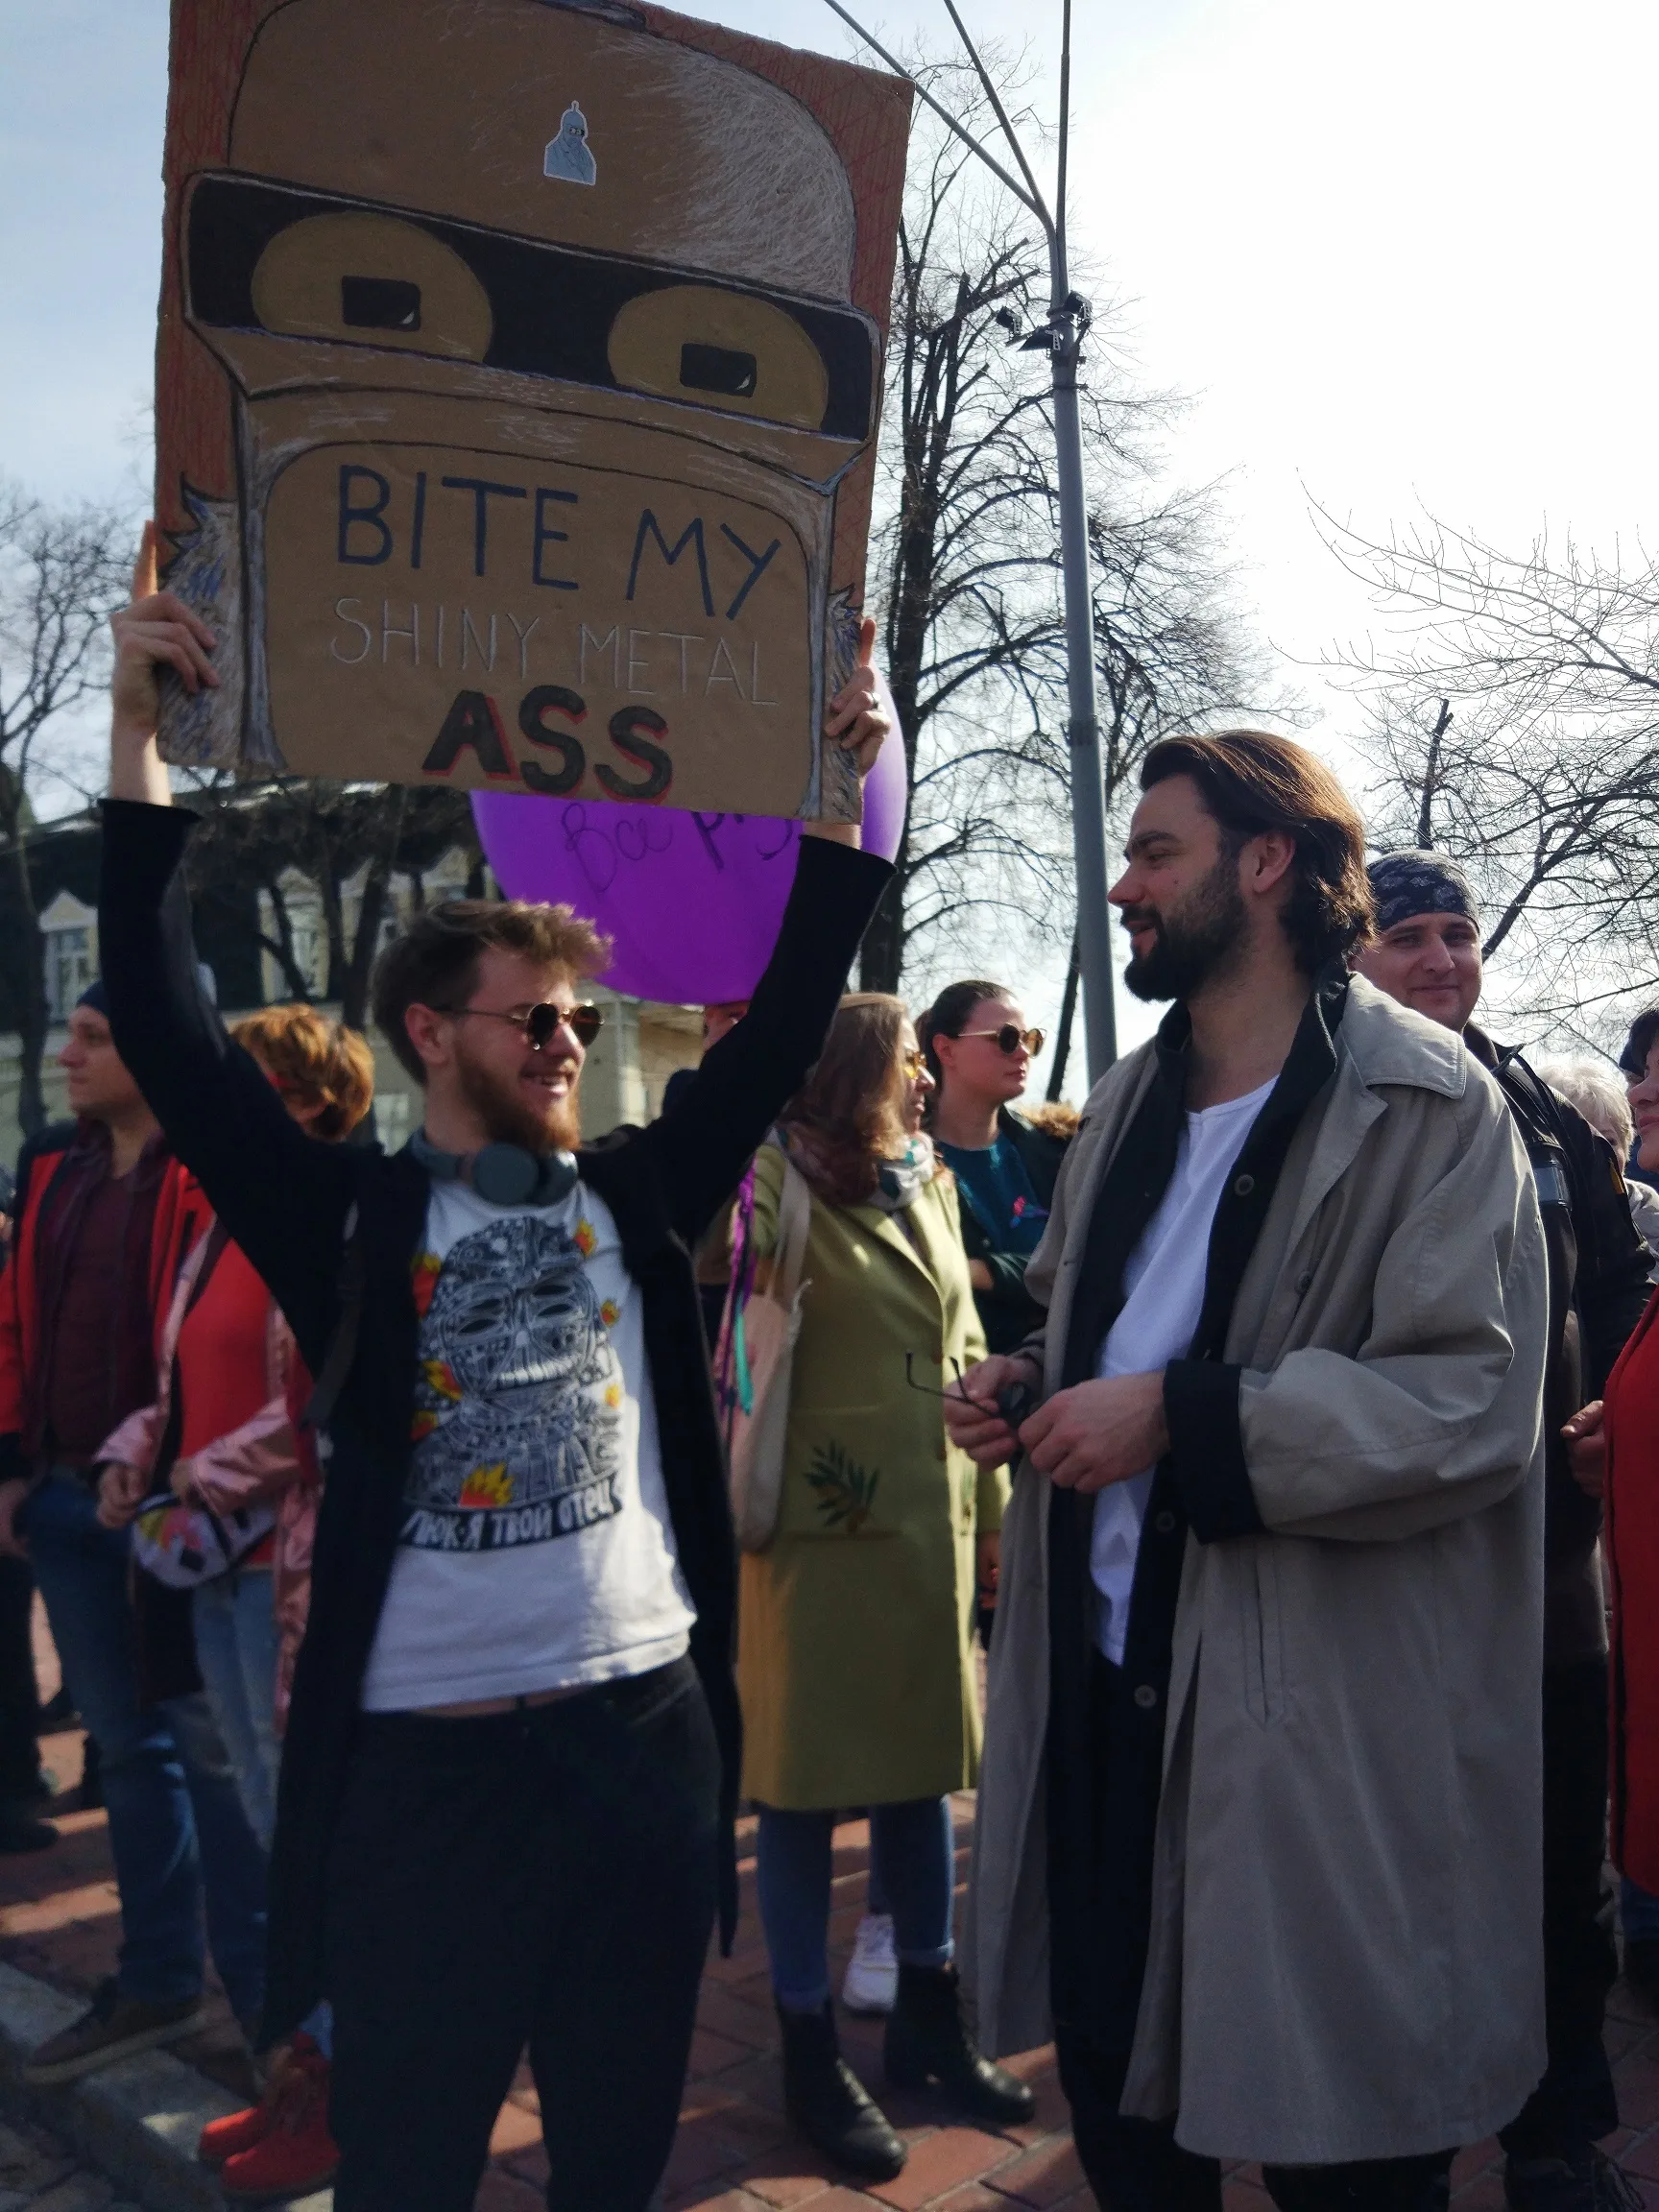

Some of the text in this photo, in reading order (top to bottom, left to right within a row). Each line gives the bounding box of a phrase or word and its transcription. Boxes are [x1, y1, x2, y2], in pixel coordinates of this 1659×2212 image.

[337, 465, 781, 620] BITE MY
[330, 597, 779, 706] SHINY METAL
[421, 685, 675, 803] ASS
